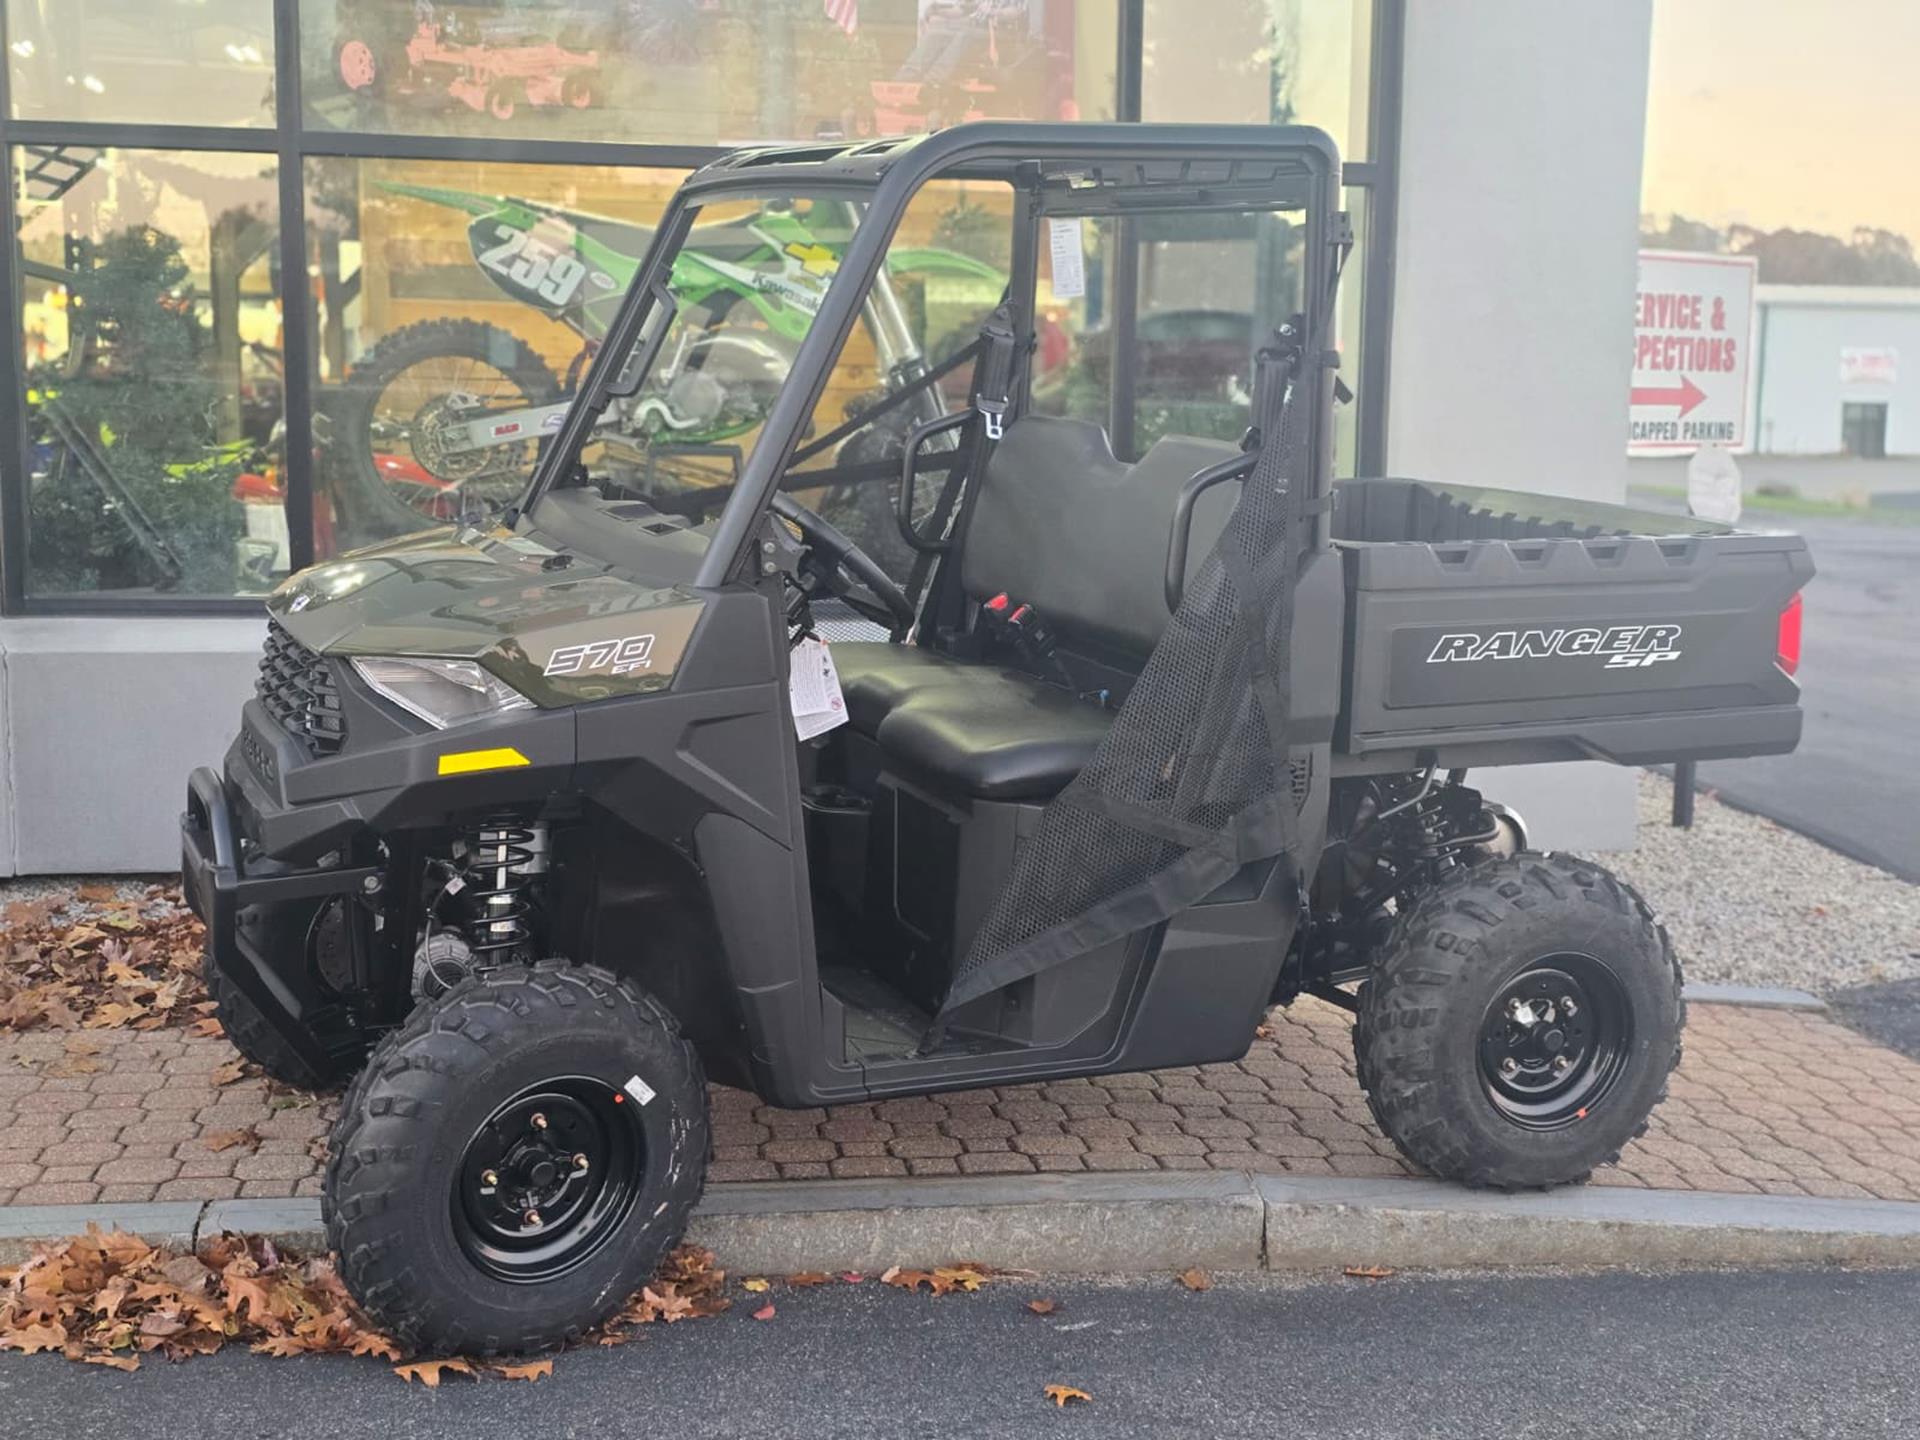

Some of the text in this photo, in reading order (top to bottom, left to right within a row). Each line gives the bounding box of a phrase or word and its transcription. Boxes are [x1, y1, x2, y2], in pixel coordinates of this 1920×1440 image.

[479, 224, 586, 305] 259
[1711, 296, 1726, 331] &
[1630, 421, 1735, 440] CAPPED PARKING
[543, 634, 655, 676] 570
[1426, 625, 1681, 663] RANGER
[1604, 651, 1682, 668] SP
